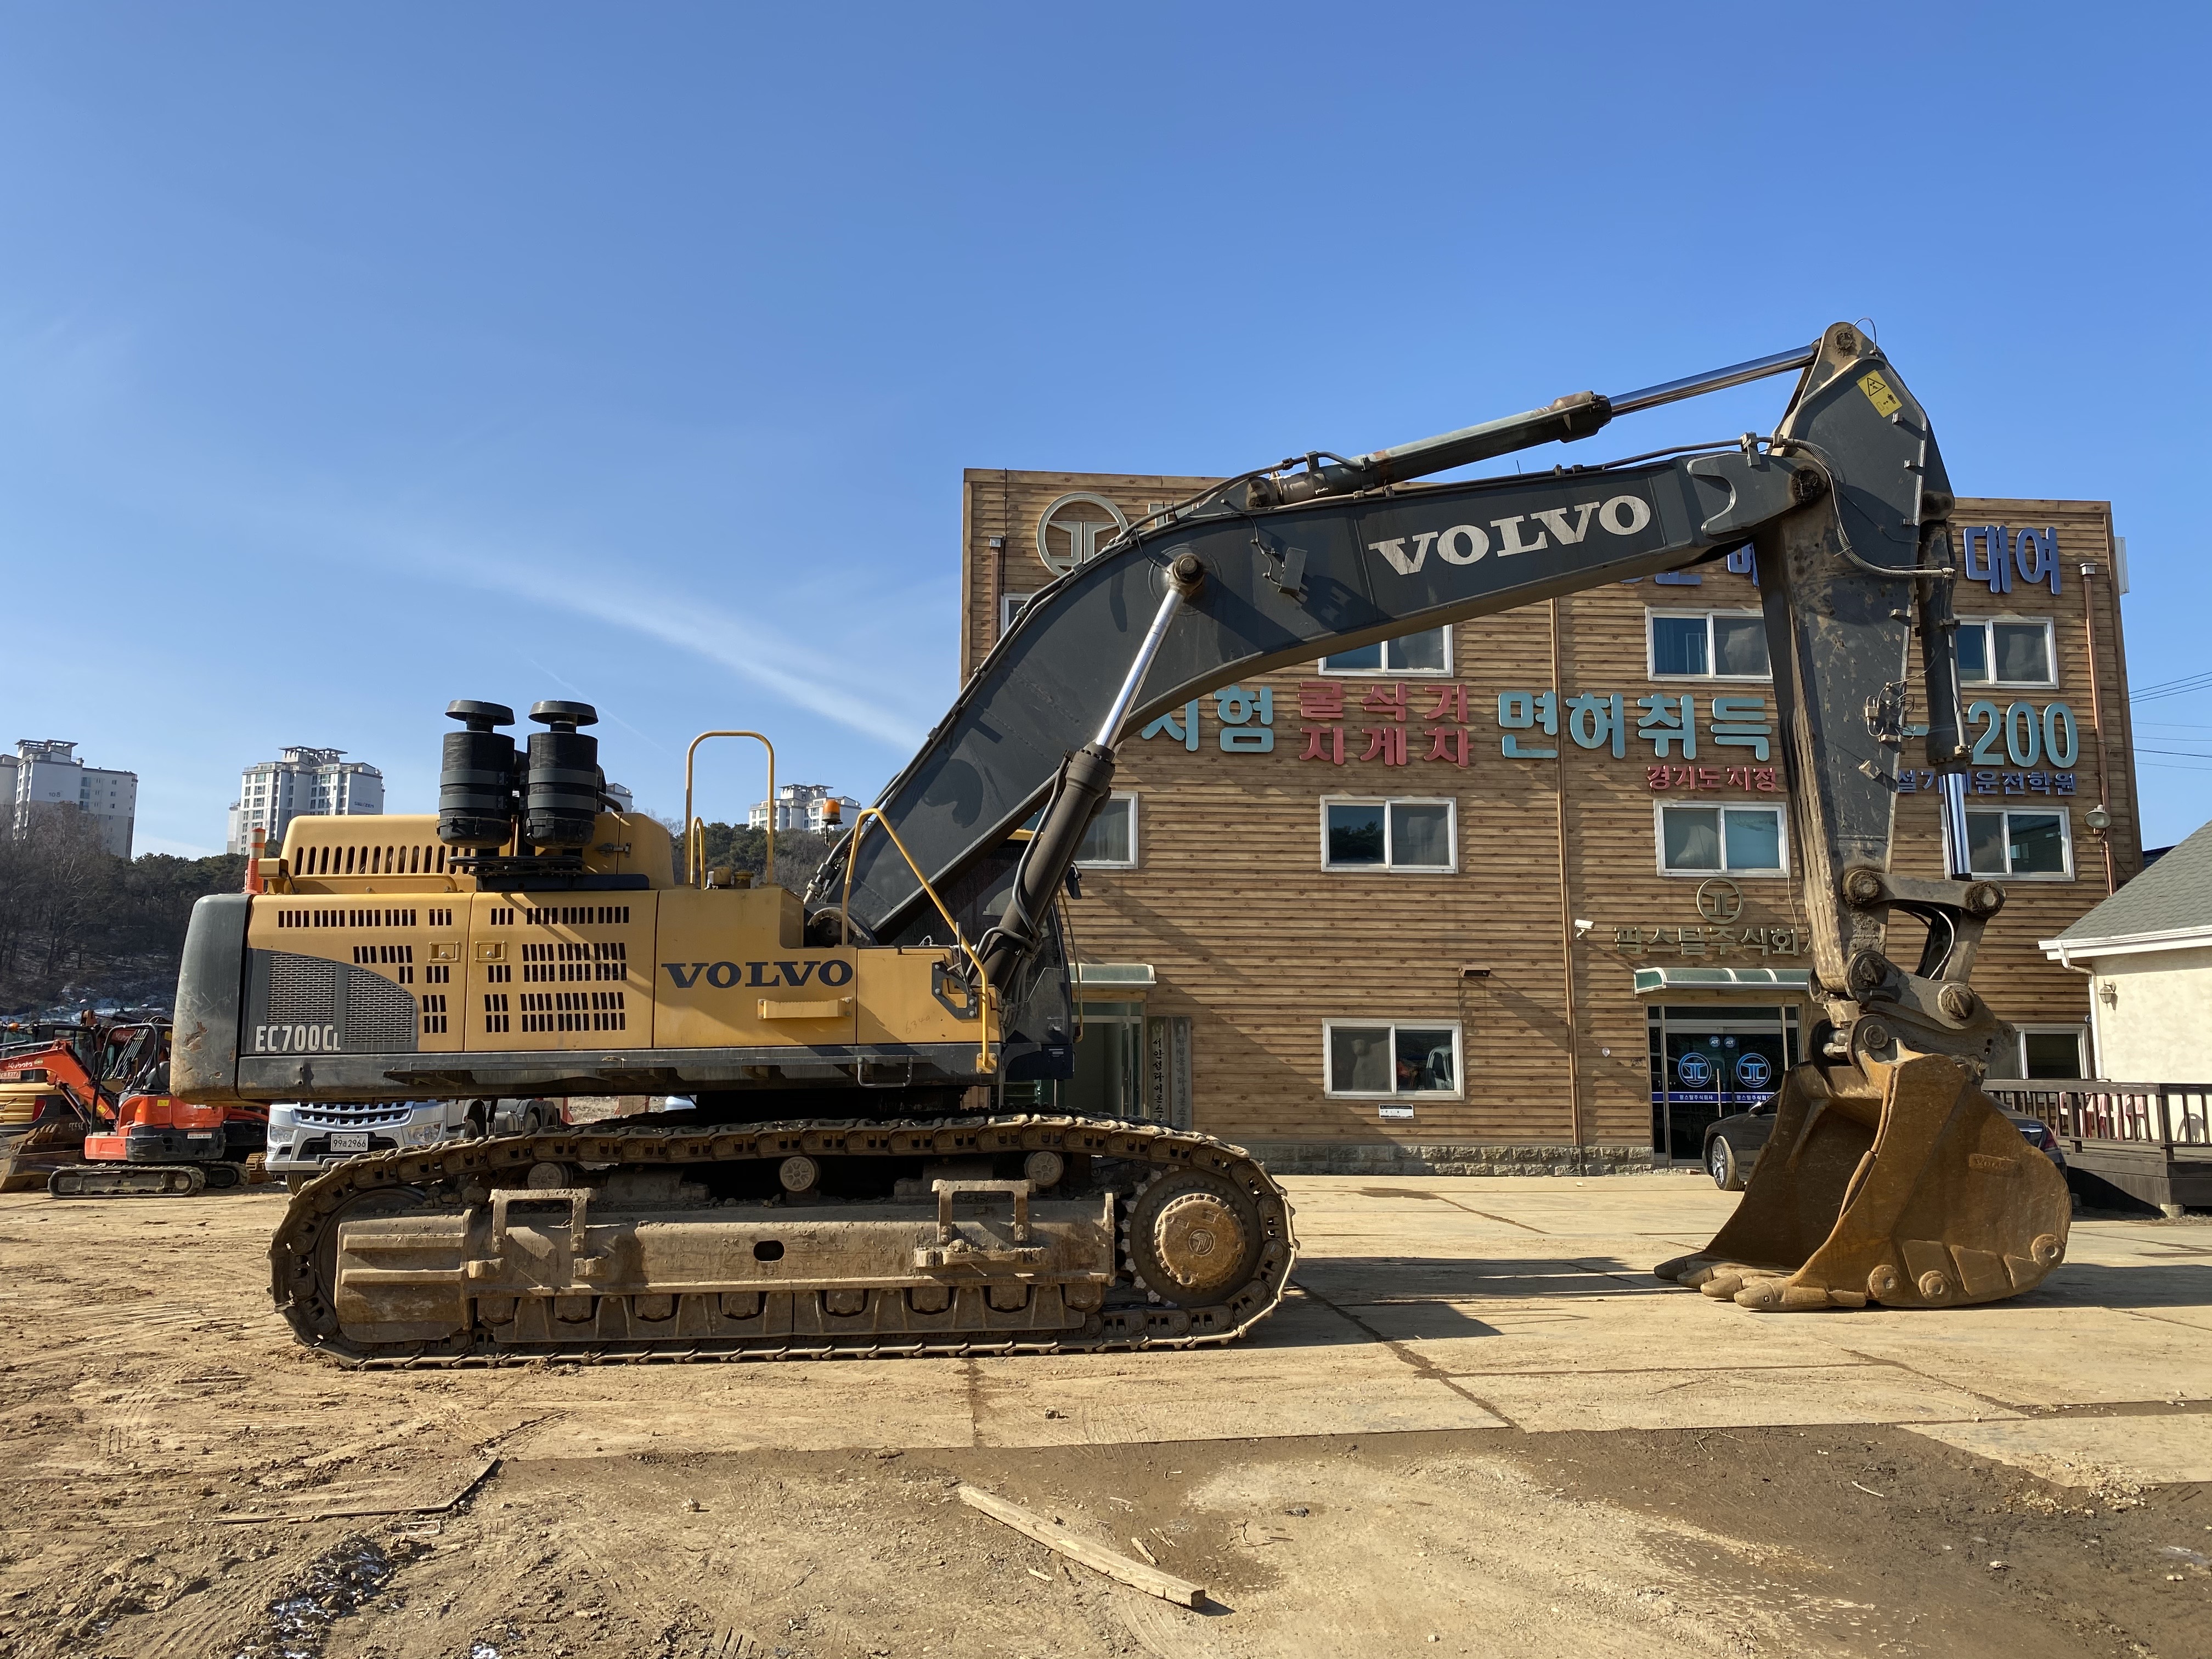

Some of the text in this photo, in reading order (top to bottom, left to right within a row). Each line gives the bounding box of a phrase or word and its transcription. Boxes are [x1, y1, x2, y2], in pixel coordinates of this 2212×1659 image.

[1369, 495, 1651, 575] VOLVO
[1963, 524, 2062, 595] 대여
[1297, 681, 1469, 723] 굴삭기
[1498, 691, 1772, 761] 면허취득
[1299, 726, 1474, 768] 지게차
[661, 960, 853, 988] VOLVO
